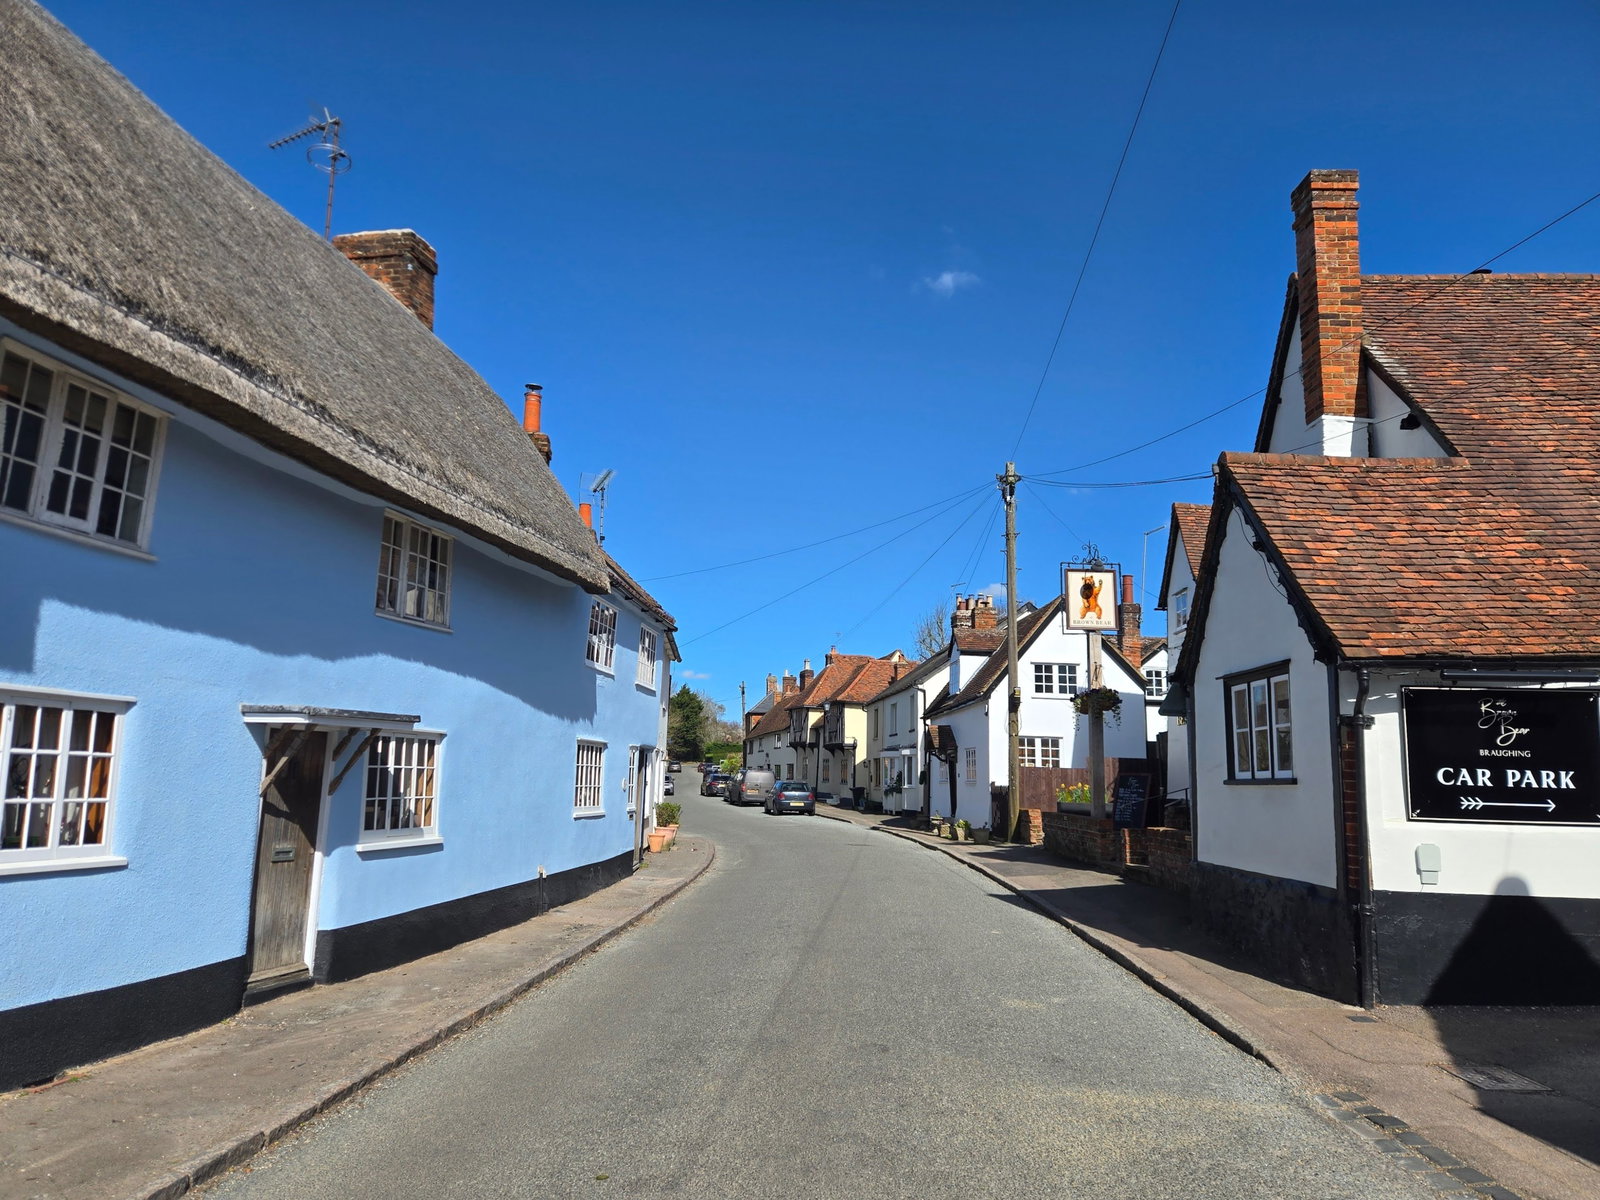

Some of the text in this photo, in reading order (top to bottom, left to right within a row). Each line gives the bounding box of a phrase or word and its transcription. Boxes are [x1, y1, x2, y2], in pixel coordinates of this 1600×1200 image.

[1496, 715, 1530, 747] Bear
[1479, 749, 1531, 758] BRAUGHING
[1436, 767, 1576, 789] CAR PARK
